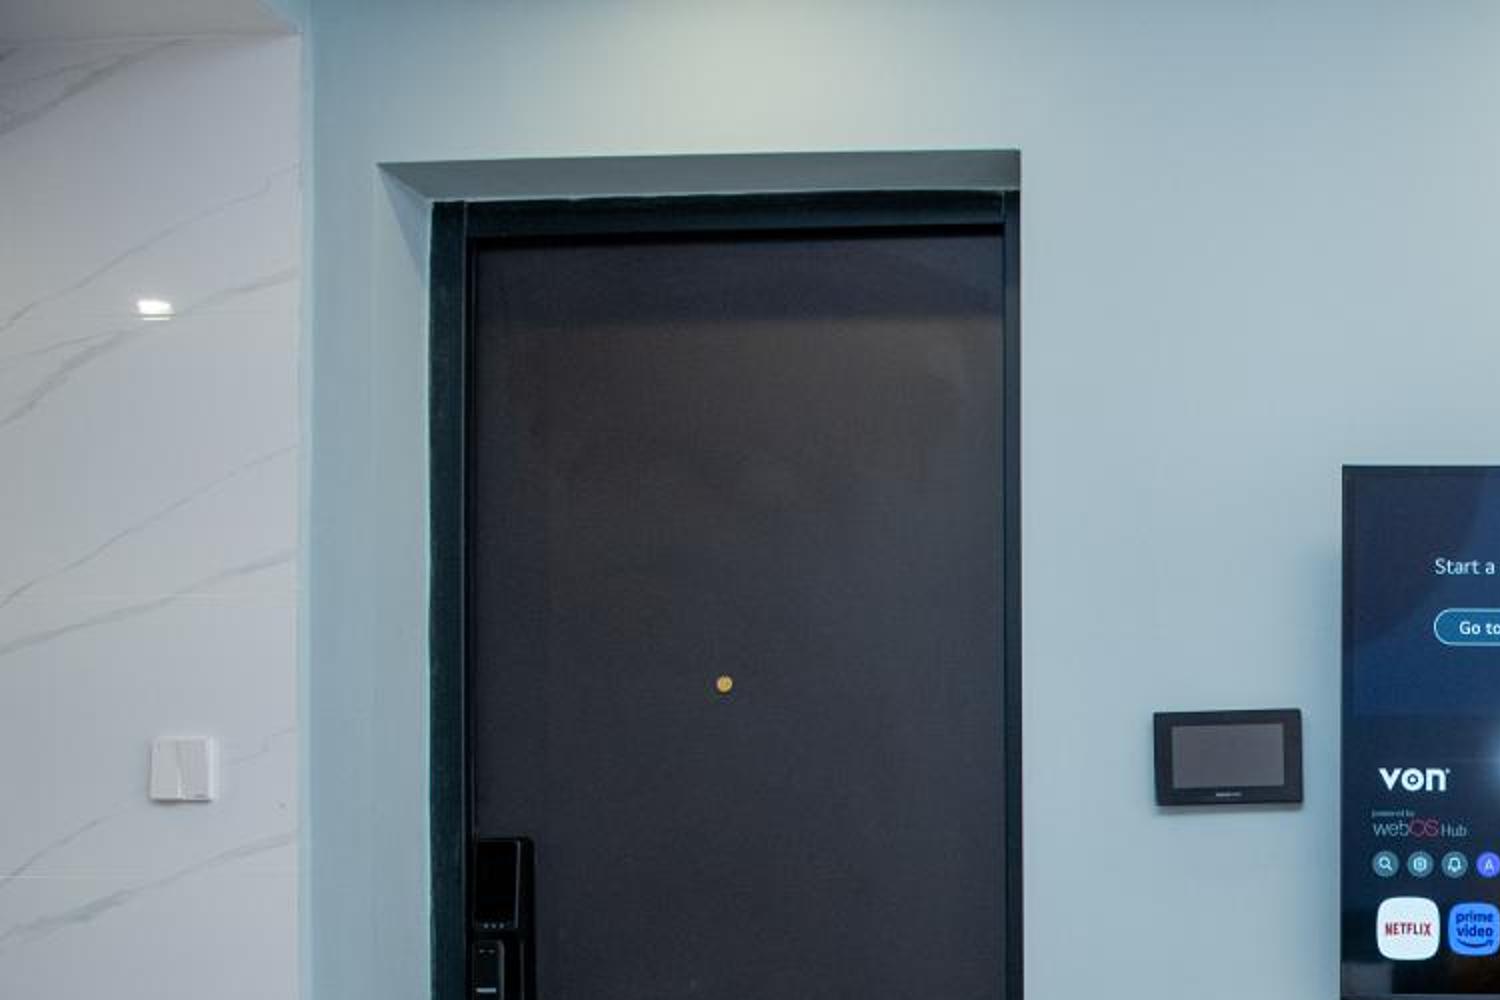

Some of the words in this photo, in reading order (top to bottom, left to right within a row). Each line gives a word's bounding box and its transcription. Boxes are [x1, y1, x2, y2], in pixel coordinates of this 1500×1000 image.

[1435, 557, 1480, 576] Start
[1485, 562, 1495, 575] a
[1459, 621, 1481, 635] Go
[1378, 767, 1448, 791] von
[1373, 819, 1440, 837] webOS
[1441, 823, 1468, 837] Hub
[1455, 910, 1493, 924] prime
[1385, 922, 1432, 936] NETFLIX
[1456, 924, 1493, 937] video
